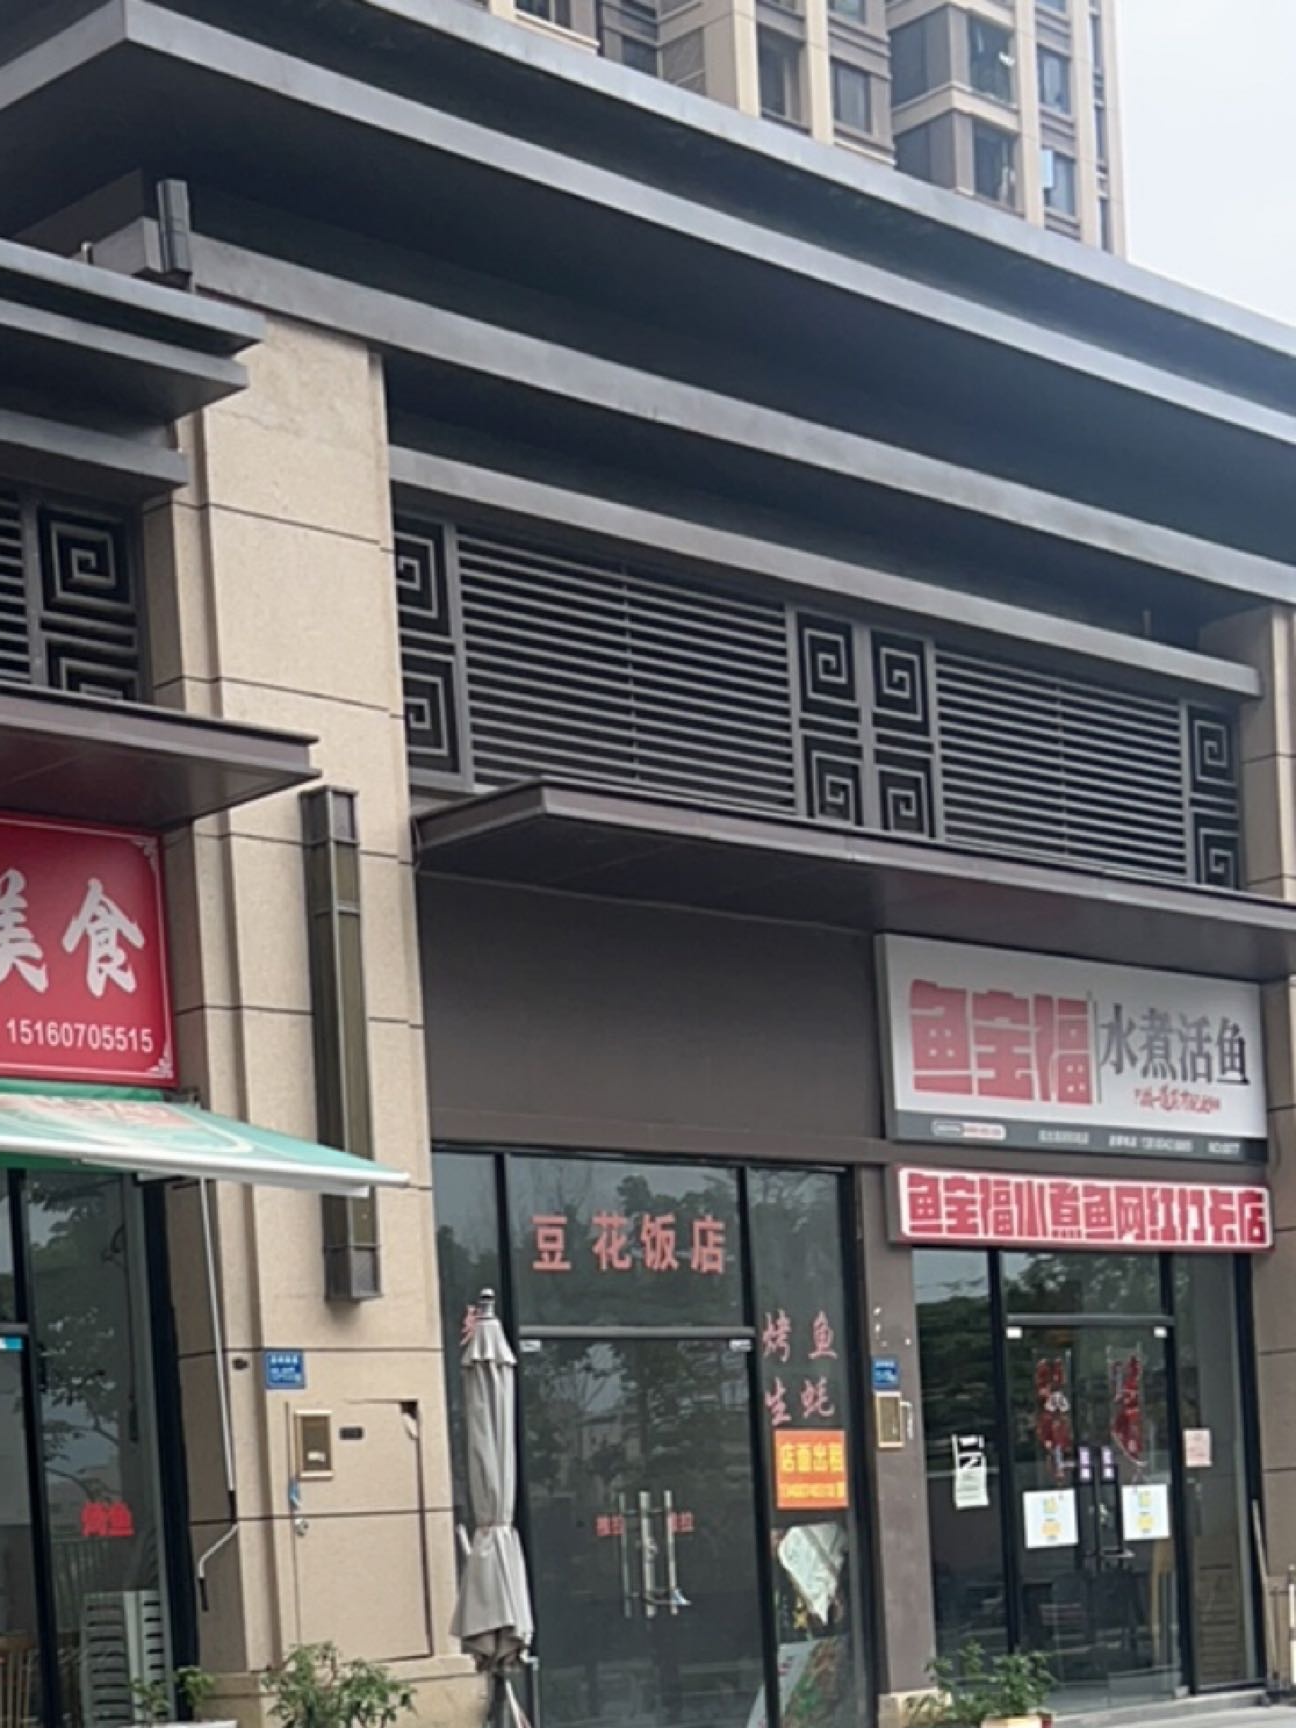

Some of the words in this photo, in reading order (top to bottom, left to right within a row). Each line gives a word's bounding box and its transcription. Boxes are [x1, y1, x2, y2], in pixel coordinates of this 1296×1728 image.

[1099, 1002, 1251, 1086] 水煮活鱼
[531, 1213, 728, 1275] 豆花饭店
[762, 1308, 838, 1363] 烤鱼
[764, 1375, 835, 1426] 生蚝
